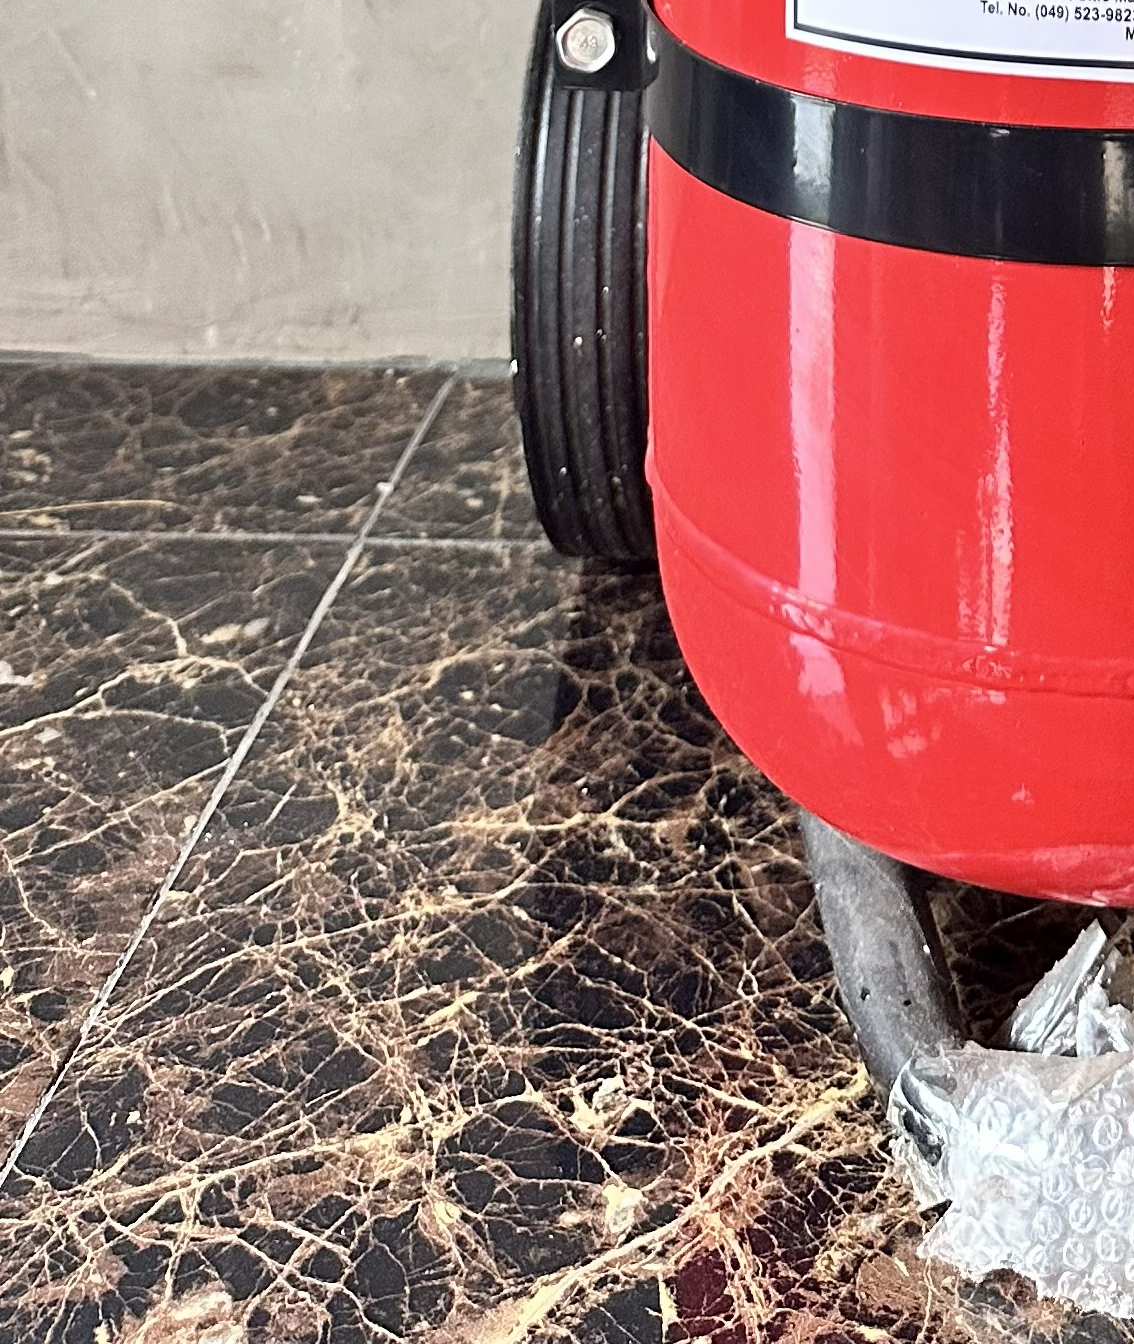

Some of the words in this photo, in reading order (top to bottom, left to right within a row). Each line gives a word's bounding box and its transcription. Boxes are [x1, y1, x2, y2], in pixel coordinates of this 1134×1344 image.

[980, 0, 1002, 14] Tel.
[1008, 3, 1030, 16] No.
[1036, 4, 1068, 22] (049)
